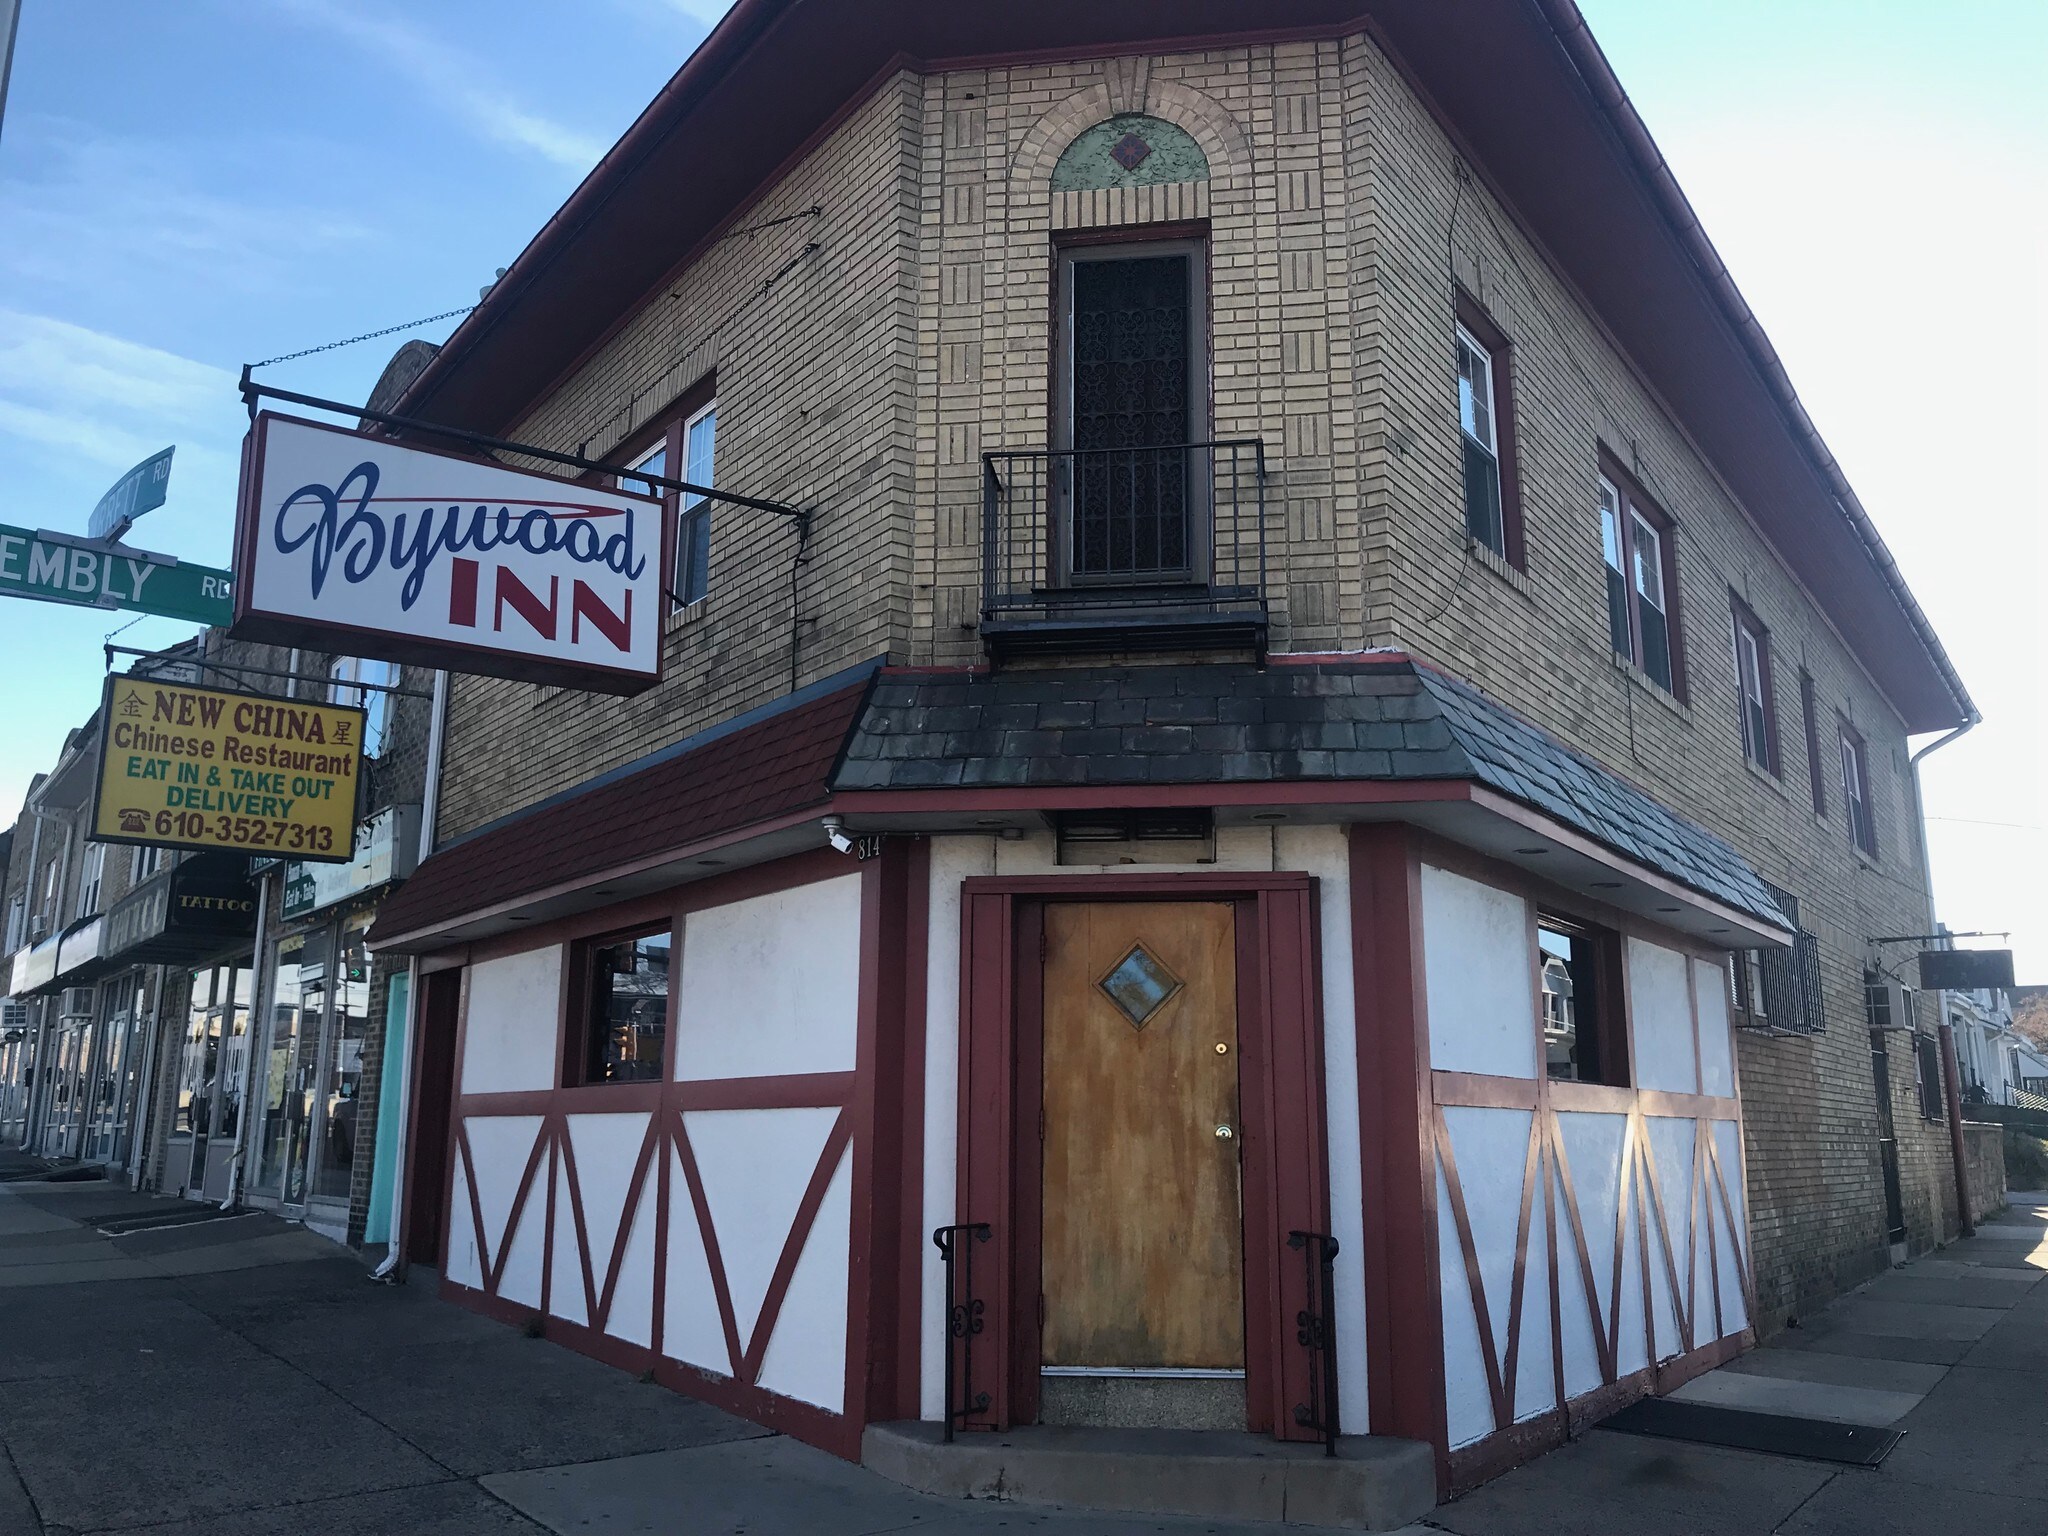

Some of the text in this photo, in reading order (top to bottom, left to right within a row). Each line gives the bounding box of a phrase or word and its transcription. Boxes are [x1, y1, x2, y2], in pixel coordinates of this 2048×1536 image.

[153, 457, 170, 484] RD
[274, 461, 646, 612] Bywood
[449, 557, 632, 653] INN
[118, 690, 149, 717] 金
[153, 690, 326, 744] NEW CHINA
[114, 722, 352, 777] Chinese Restaurant
[330, 720, 354, 746] 星
[126, 756, 335, 800] EAT IN & TAKE OUT
[166, 786, 295, 819] DELIVERY
[154, 809, 334, 851] 610-352-7313
[858, 836, 880, 859] 814
[178, 894, 254, 913] TATTOO
